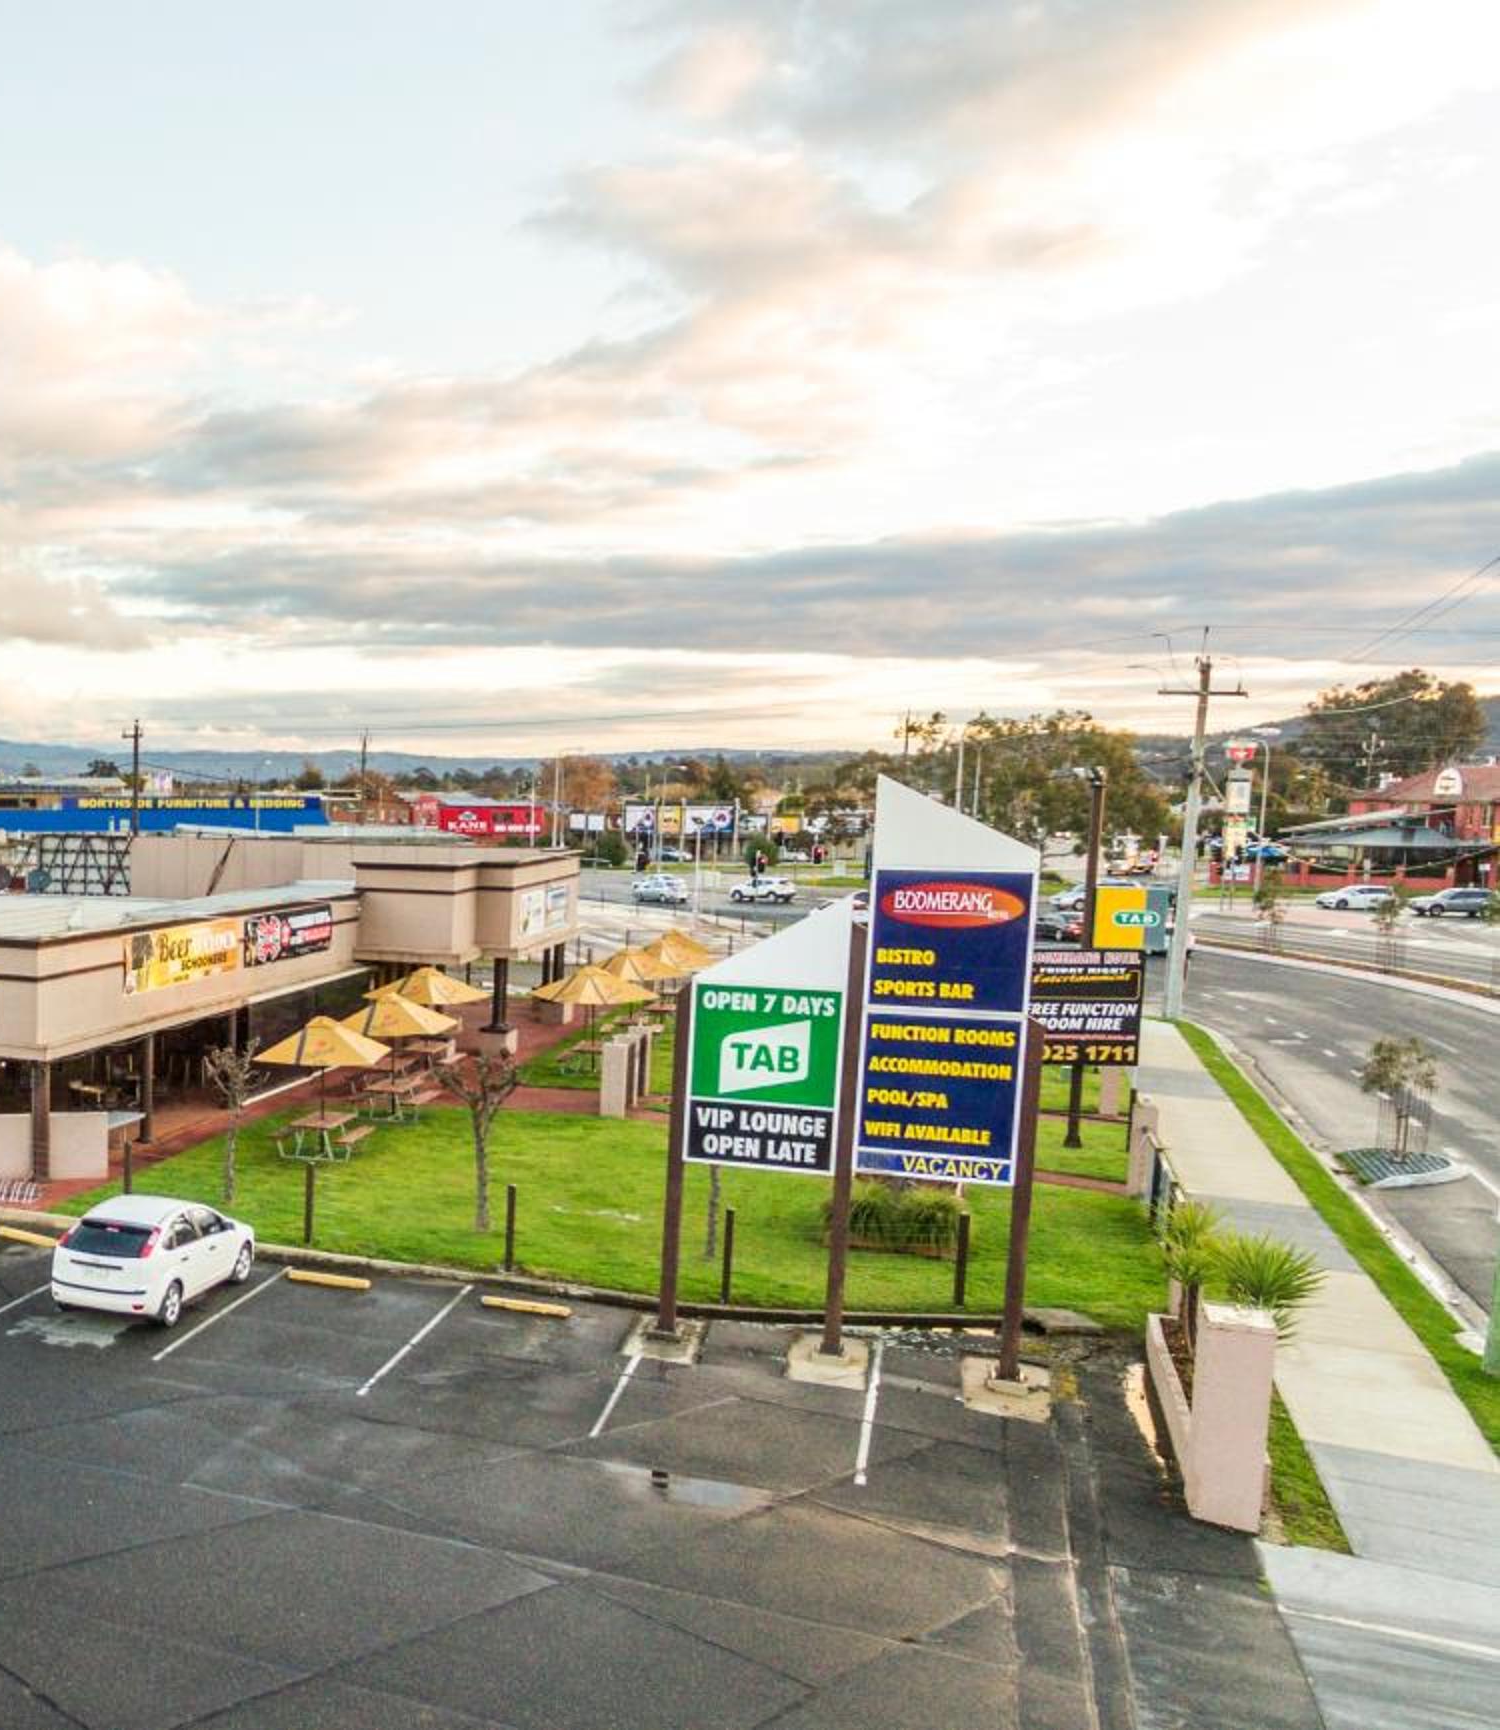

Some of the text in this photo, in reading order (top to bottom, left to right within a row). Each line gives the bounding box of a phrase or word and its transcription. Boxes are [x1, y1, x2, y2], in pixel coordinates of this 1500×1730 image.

[78, 799, 153, 809] NORTHSDE
[158, 799, 229, 809] FURNITURE
[234, 799, 244, 809] &
[448, 821, 487, 829] KANE
[893, 890, 992, 911] BOOMERANG
[1121, 913, 1154, 925] TAB
[875, 948, 935, 965] BISTRO
[873, 979, 975, 1000] SPORTS BAR
[703, 991, 835, 1017] OPEN 7 DAYS
[1061, 1003, 1138, 1016] FUNCTION
[871, 1023, 1016, 1046] FUNCTION ROOMS
[1085, 1019, 1124, 1031] HIRE
[730, 1042, 799, 1073] TAB
[1085, 1045, 1135, 1061] 1711
[868, 1056, 1013, 1080] ACCOMMODATION
[867, 1088, 948, 1109] POOL/SPA
[697, 1107, 827, 1138] VIP LOUNGE
[865, 1120, 991, 1145] WIFI AVAILABLE
[703, 1133, 817, 1163] OPEN LATE
[902, 1156, 1002, 1179] VACANCY
